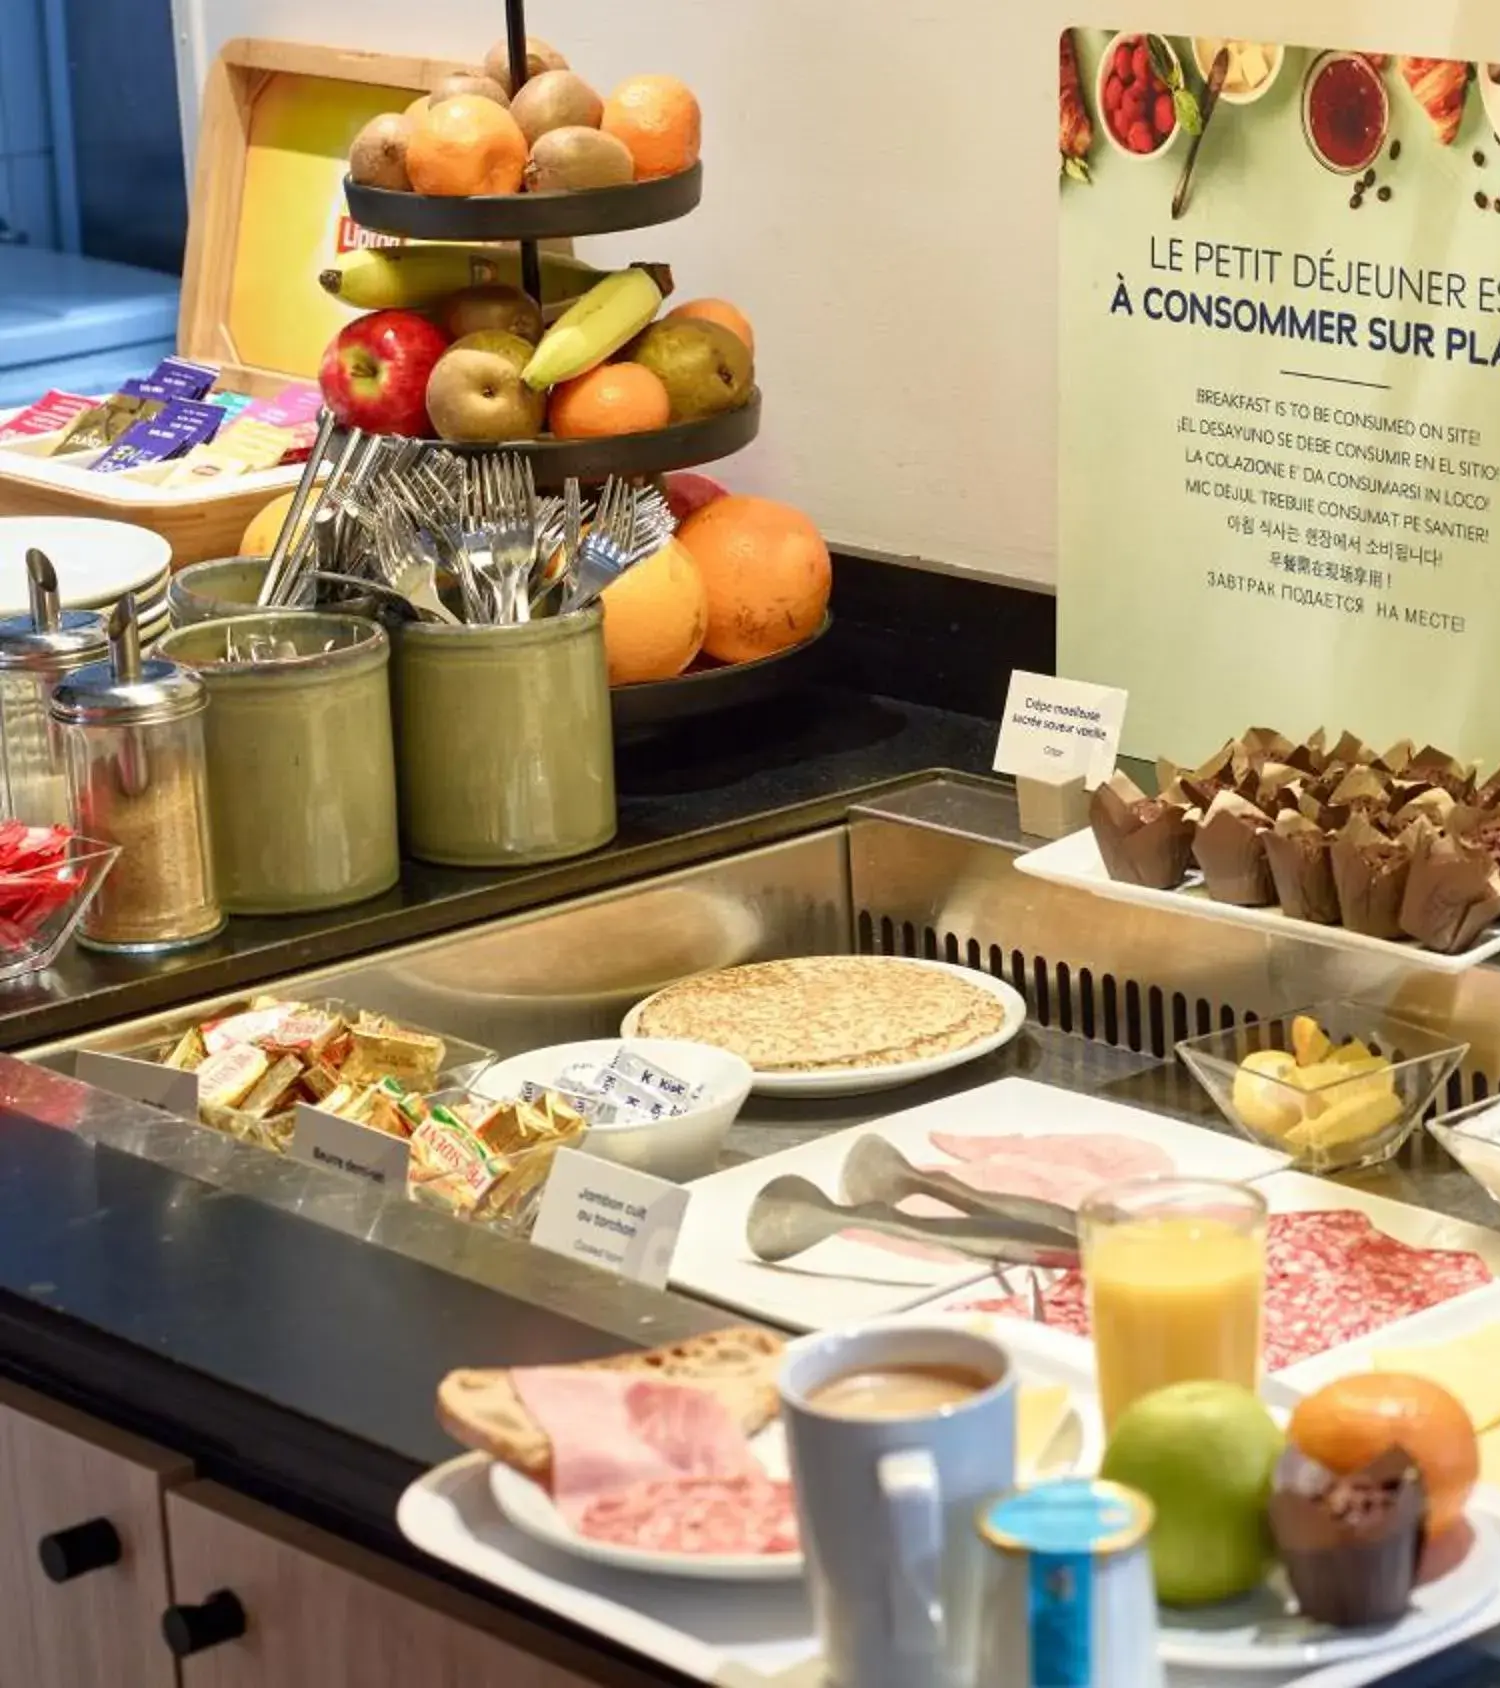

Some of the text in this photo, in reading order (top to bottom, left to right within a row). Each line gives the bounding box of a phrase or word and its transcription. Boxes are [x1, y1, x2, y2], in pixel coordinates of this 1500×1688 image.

[1151, 236, 1183, 271] LE
[1194, 241, 1282, 284] PETIT
[1294, 248, 1466, 309] DÉJEUNER
[1111, 273, 1133, 316] À
[1144, 288, 1357, 347] CONSOMMER
[1368, 318, 1434, 357] SUR
[1196, 388, 1271, 414] BREAKFAST
[1275, 400, 1286, 416] IS
[1291, 403, 1310, 419] TO
[1314, 406, 1330, 422] BE
[1333, 409, 1414, 436] CONSUMED
[1420, 423, 1442, 440] ON
[1185, 446, 1202, 463] LA
[1205, 451, 1285, 477] COLAZIONE
[1303, 467, 1325, 484] DA
[1327, 471, 1421, 501] CONSUMARSI
[1425, 487, 1441, 504] IN
[1199, 420, 1275, 446] DESAYUNO
[1278, 431, 1293, 447] SE
[1297, 435, 1331, 455] DEBE
[1335, 442, 1411, 467] CONSUMIR
[1415, 453, 1435, 471] EN
[1439, 457, 1455, 475] EL
[1186, 480, 1211, 496] MIC
[1260, 489, 1314, 514] TREBUIE
[1318, 502, 1399, 528] CONSUMAT
[1404, 513, 1420, 531] PE
[1424, 518, 1489, 543] SANTIER!
[1259, 519, 1300, 543] 식사는
[1305, 527, 1361, 552] 현장에서
[1207, 571, 1275, 596] ЗАВТРАК
[1281, 584, 1364, 614] ПОДАЕТСЯ
[1376, 602, 1398, 621] НА
[578, 1188, 623, 1213] Jambon
